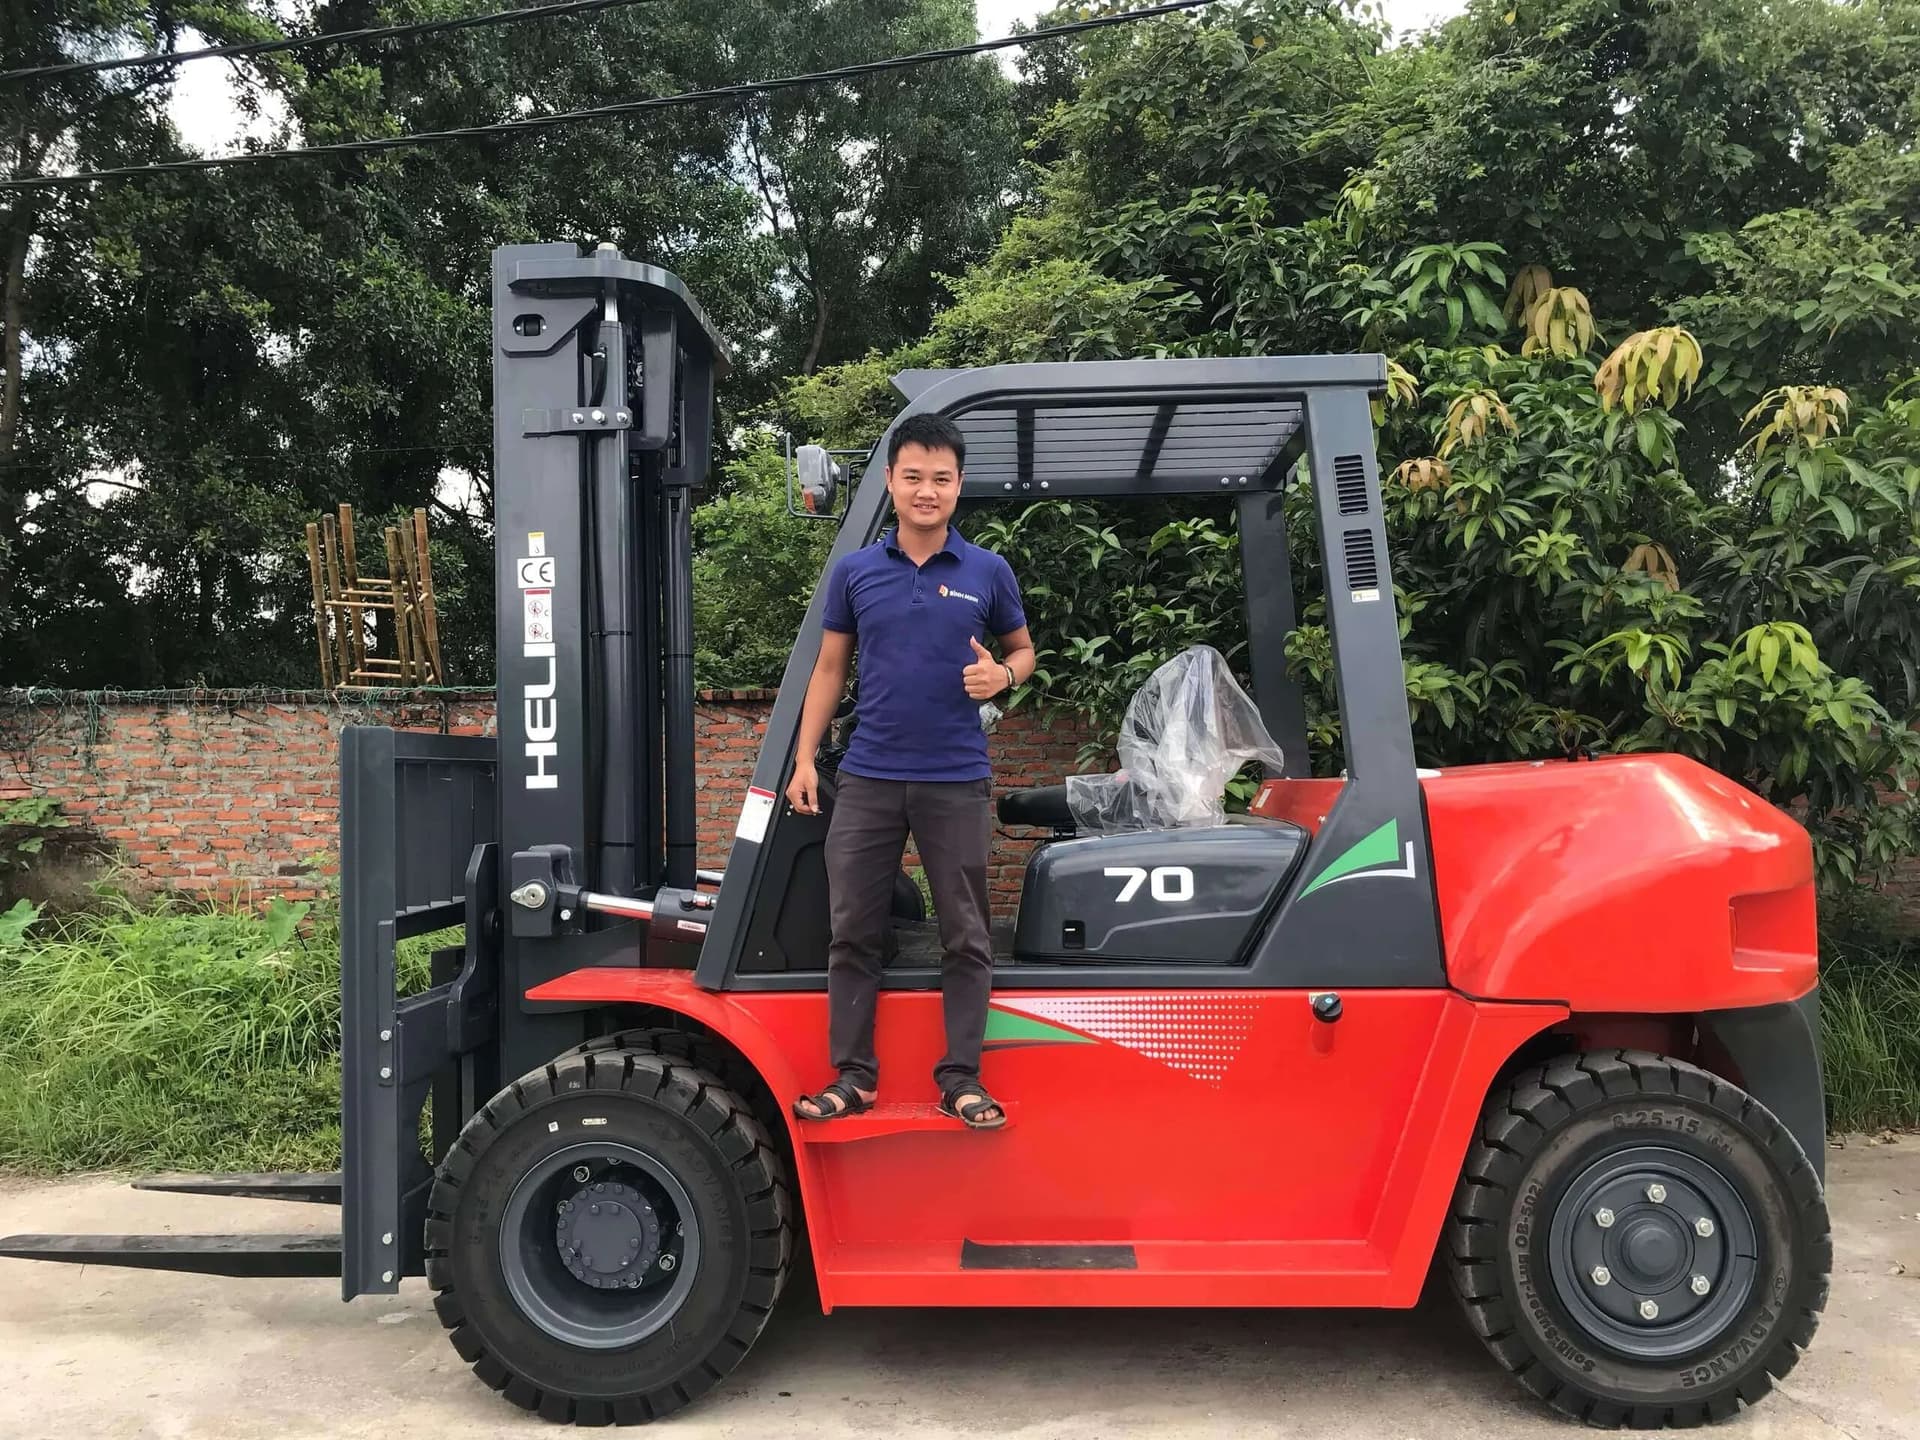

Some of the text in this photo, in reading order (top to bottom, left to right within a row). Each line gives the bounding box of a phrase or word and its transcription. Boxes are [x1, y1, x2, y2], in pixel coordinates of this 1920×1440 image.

[523, 643, 558, 789] HELI
[1103, 866, 1194, 903] 70
[1679, 1306, 1775, 1388] ADVANCE
